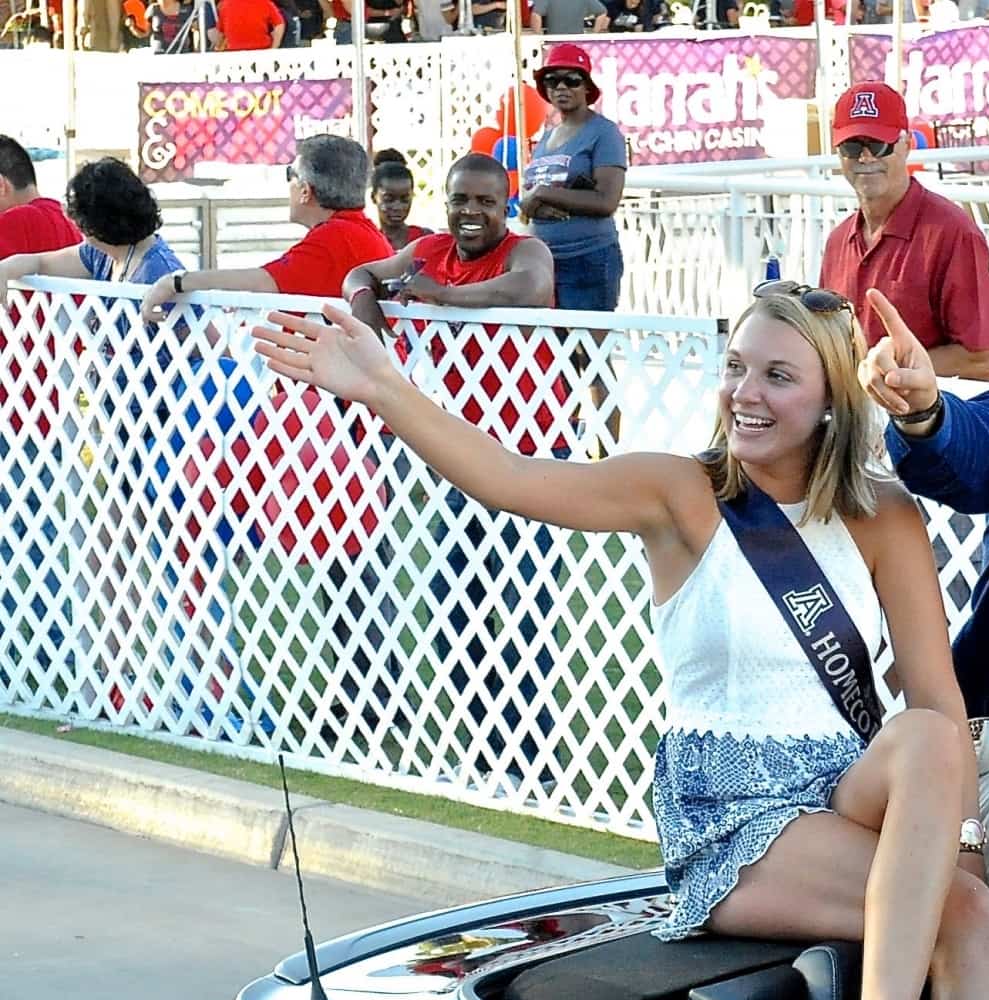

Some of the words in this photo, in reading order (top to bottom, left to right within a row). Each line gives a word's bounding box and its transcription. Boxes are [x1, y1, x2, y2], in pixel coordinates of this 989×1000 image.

[143, 89, 229, 118] COME
[849, 92, 880, 119] A
[704, 125, 766, 150] CASIN
[782, 583, 834, 636] A
